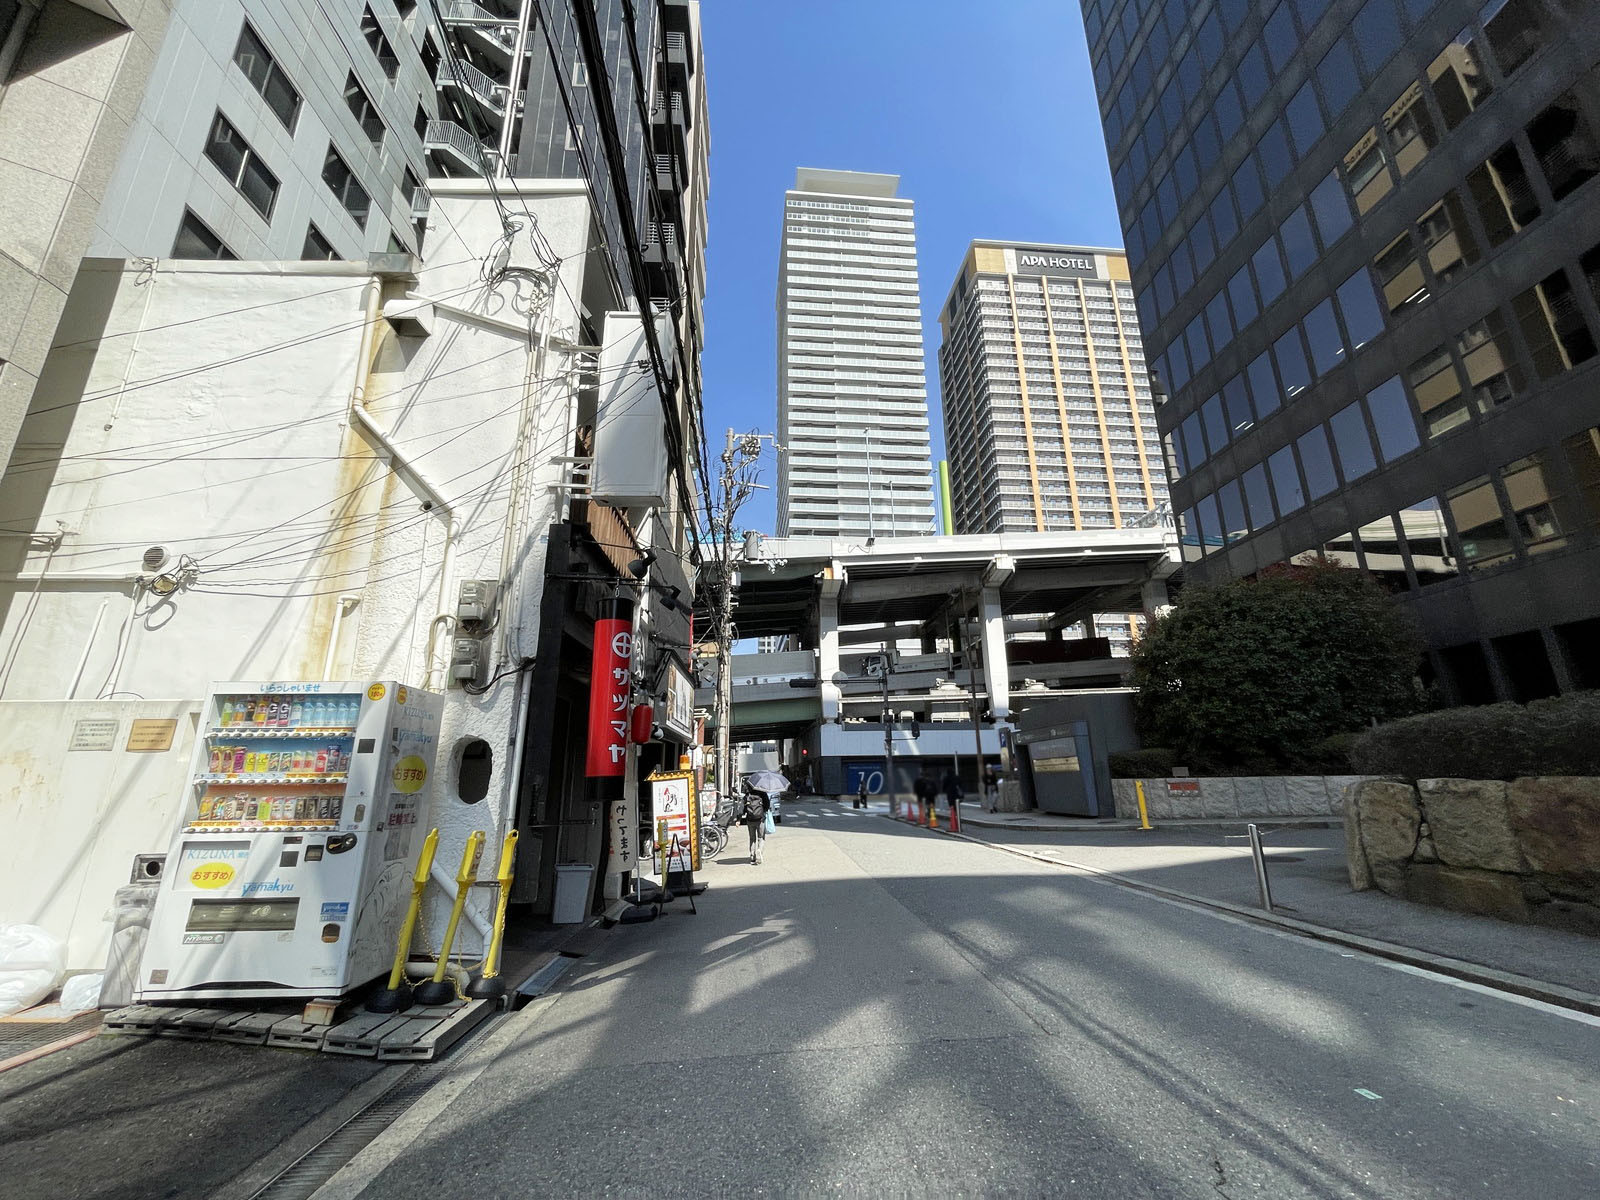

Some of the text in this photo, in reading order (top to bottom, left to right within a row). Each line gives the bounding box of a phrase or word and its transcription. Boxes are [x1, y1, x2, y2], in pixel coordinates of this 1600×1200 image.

[1021, 255, 1093, 270] APA HOTEL
[260, 683, 321, 693] いらっしゃいませ
[608, 667, 629, 763] サツマヤ
[856, 770, 884, 795] 10
[192, 871, 233, 881] おすすめ!
[241, 878, 294, 897] yamakyu
